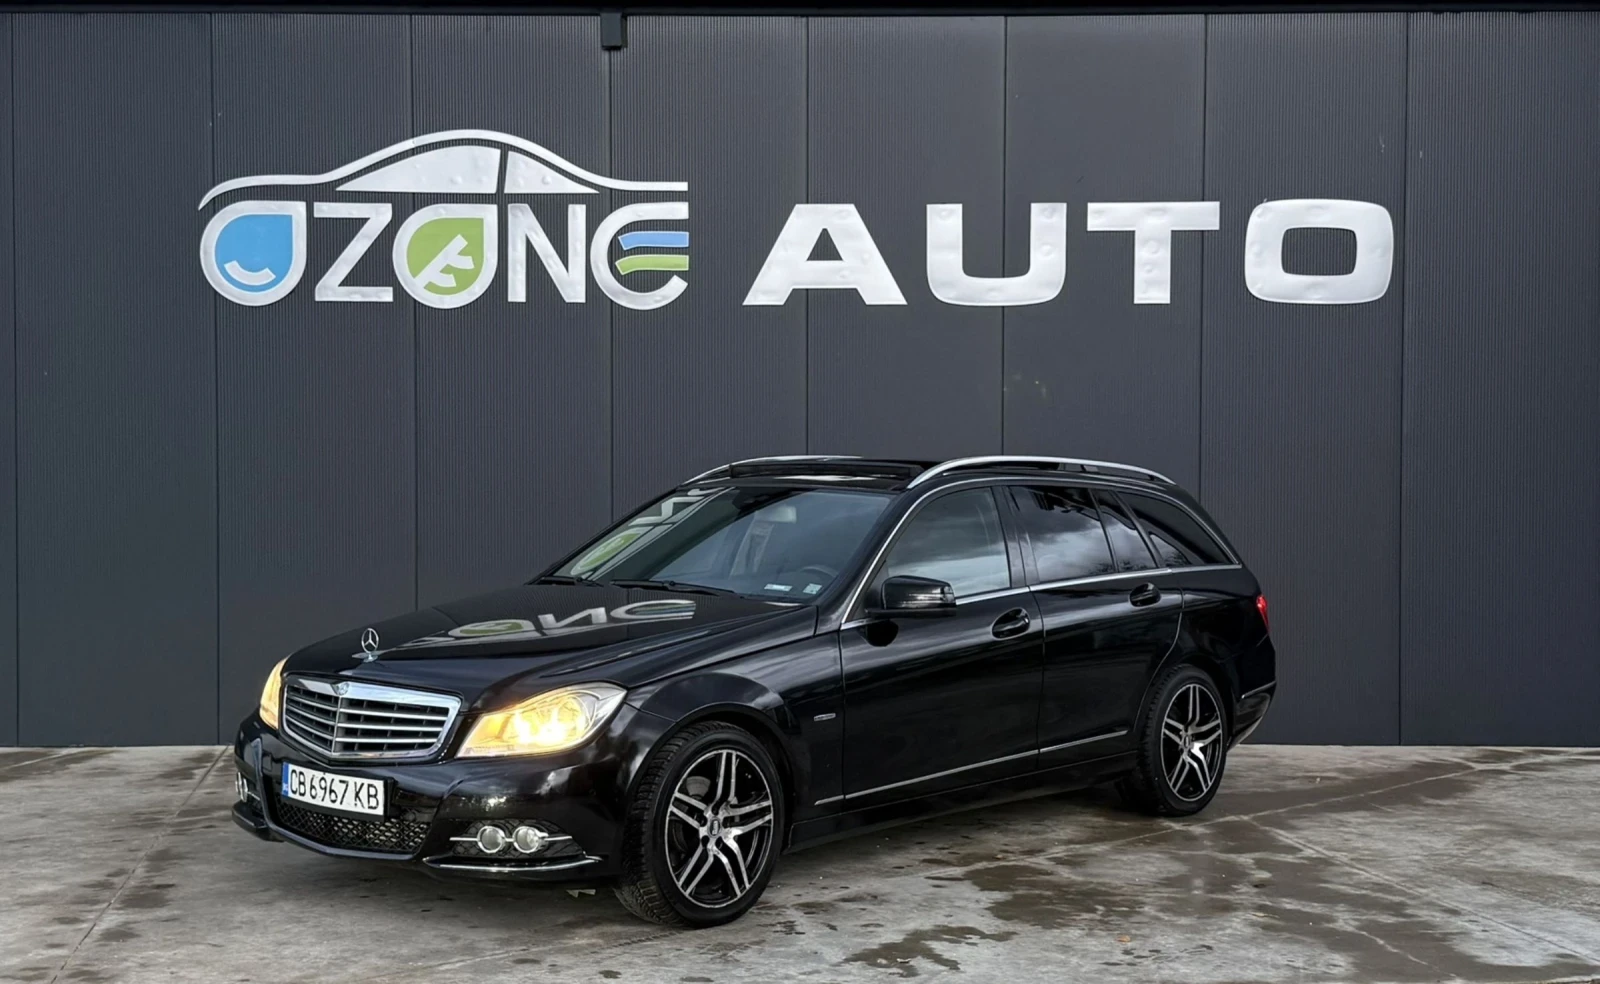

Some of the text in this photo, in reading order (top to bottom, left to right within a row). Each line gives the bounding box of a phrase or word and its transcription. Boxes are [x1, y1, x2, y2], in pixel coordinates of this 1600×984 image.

[200, 198, 1395, 310] OZONE AUTO
[290, 769, 379, 810] CB 6967 KB
